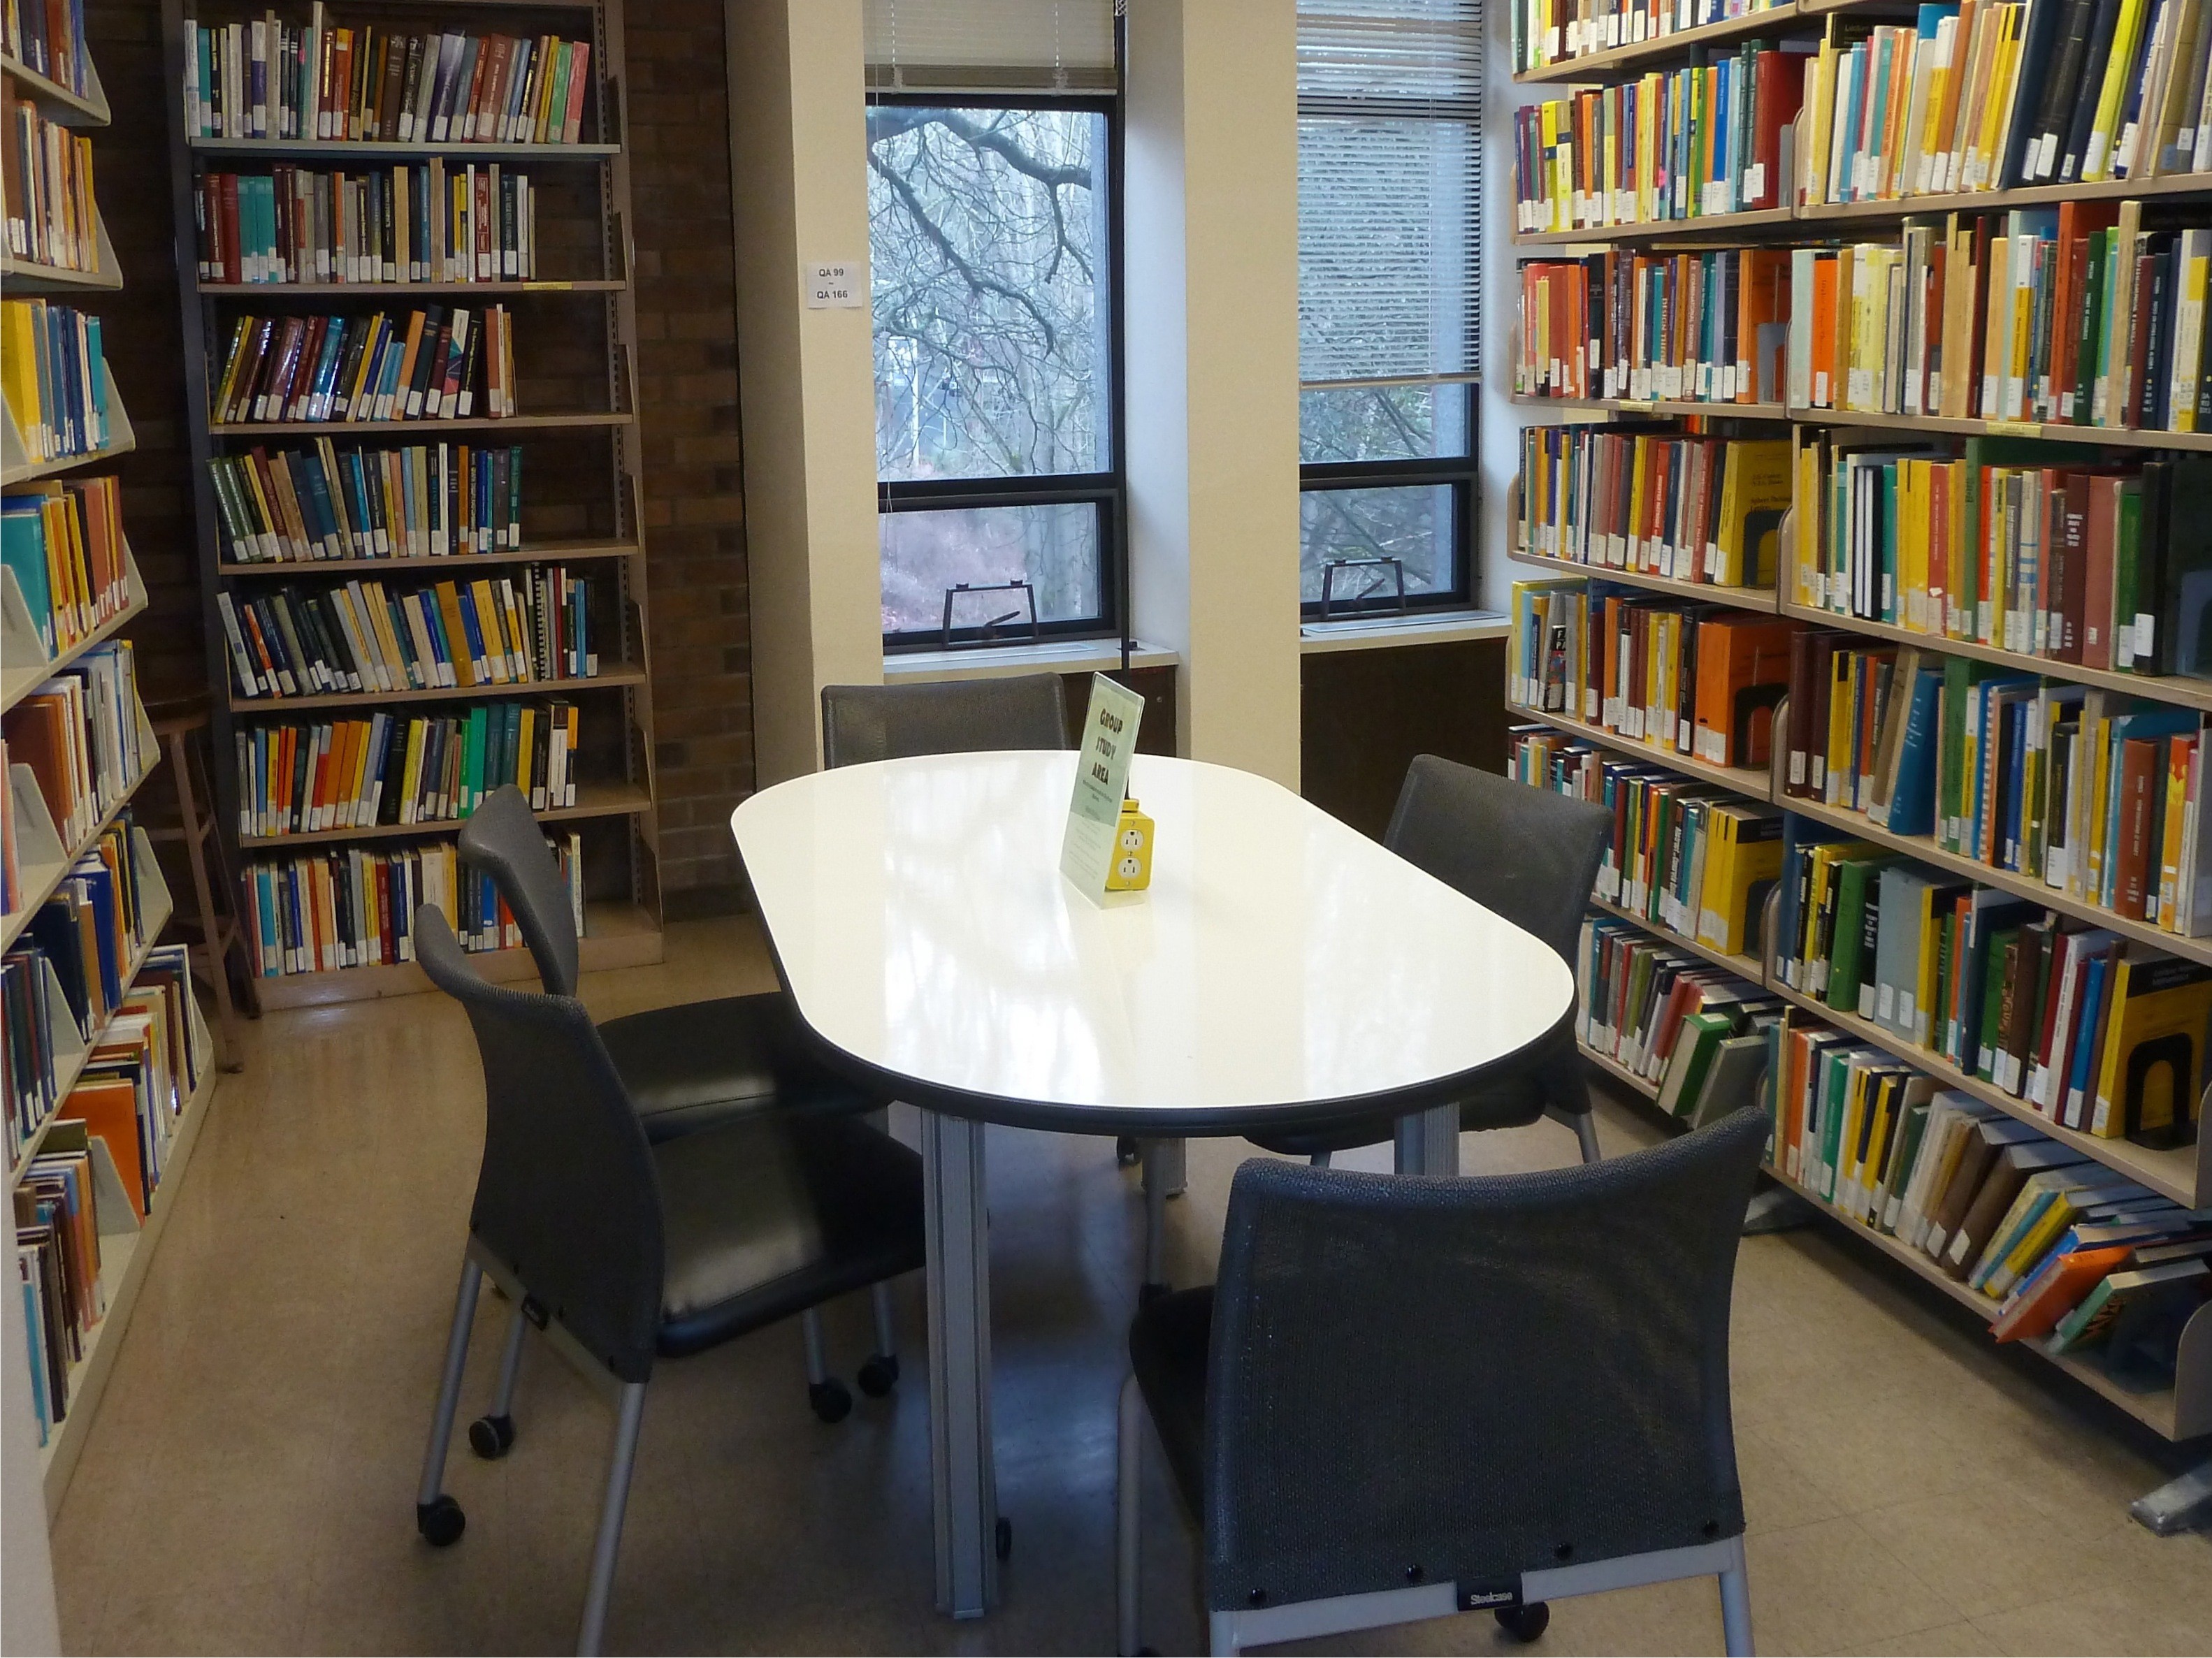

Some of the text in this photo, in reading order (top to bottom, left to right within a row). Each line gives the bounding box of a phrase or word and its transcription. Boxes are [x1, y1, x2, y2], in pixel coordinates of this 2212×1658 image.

[819, 268, 831, 277] QA
[817, 290, 848, 299] QA 166
[1100, 708, 1123, 735] GROUP
[1095, 736, 1116, 760] STUDY
[1092, 762, 1109, 785] AREA
[1470, 1592, 1513, 1606] Steelcase
